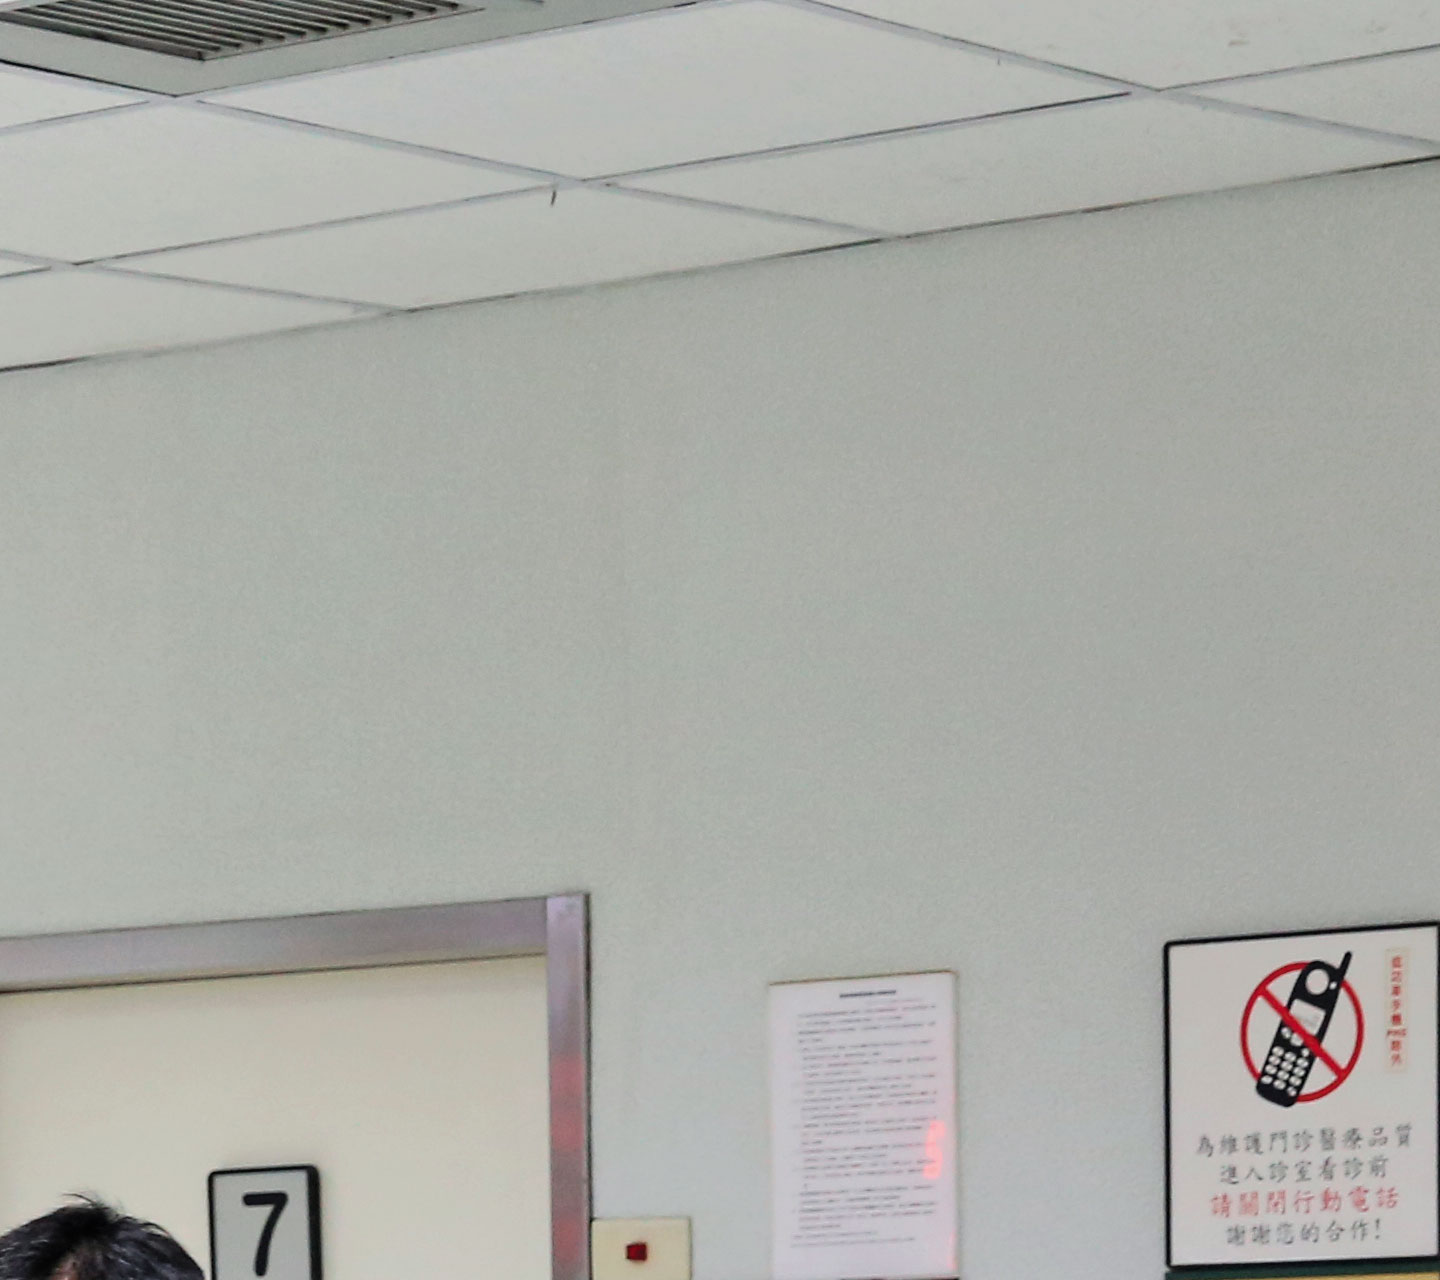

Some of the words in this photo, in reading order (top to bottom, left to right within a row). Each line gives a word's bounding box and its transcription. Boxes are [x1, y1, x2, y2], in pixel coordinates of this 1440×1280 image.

[1220, 1155, 1388, 1185] 進入診室看診前
[1210, 1185, 1400, 1218] 請關閉行動電話
[242, 1191, 289, 1277] 7
